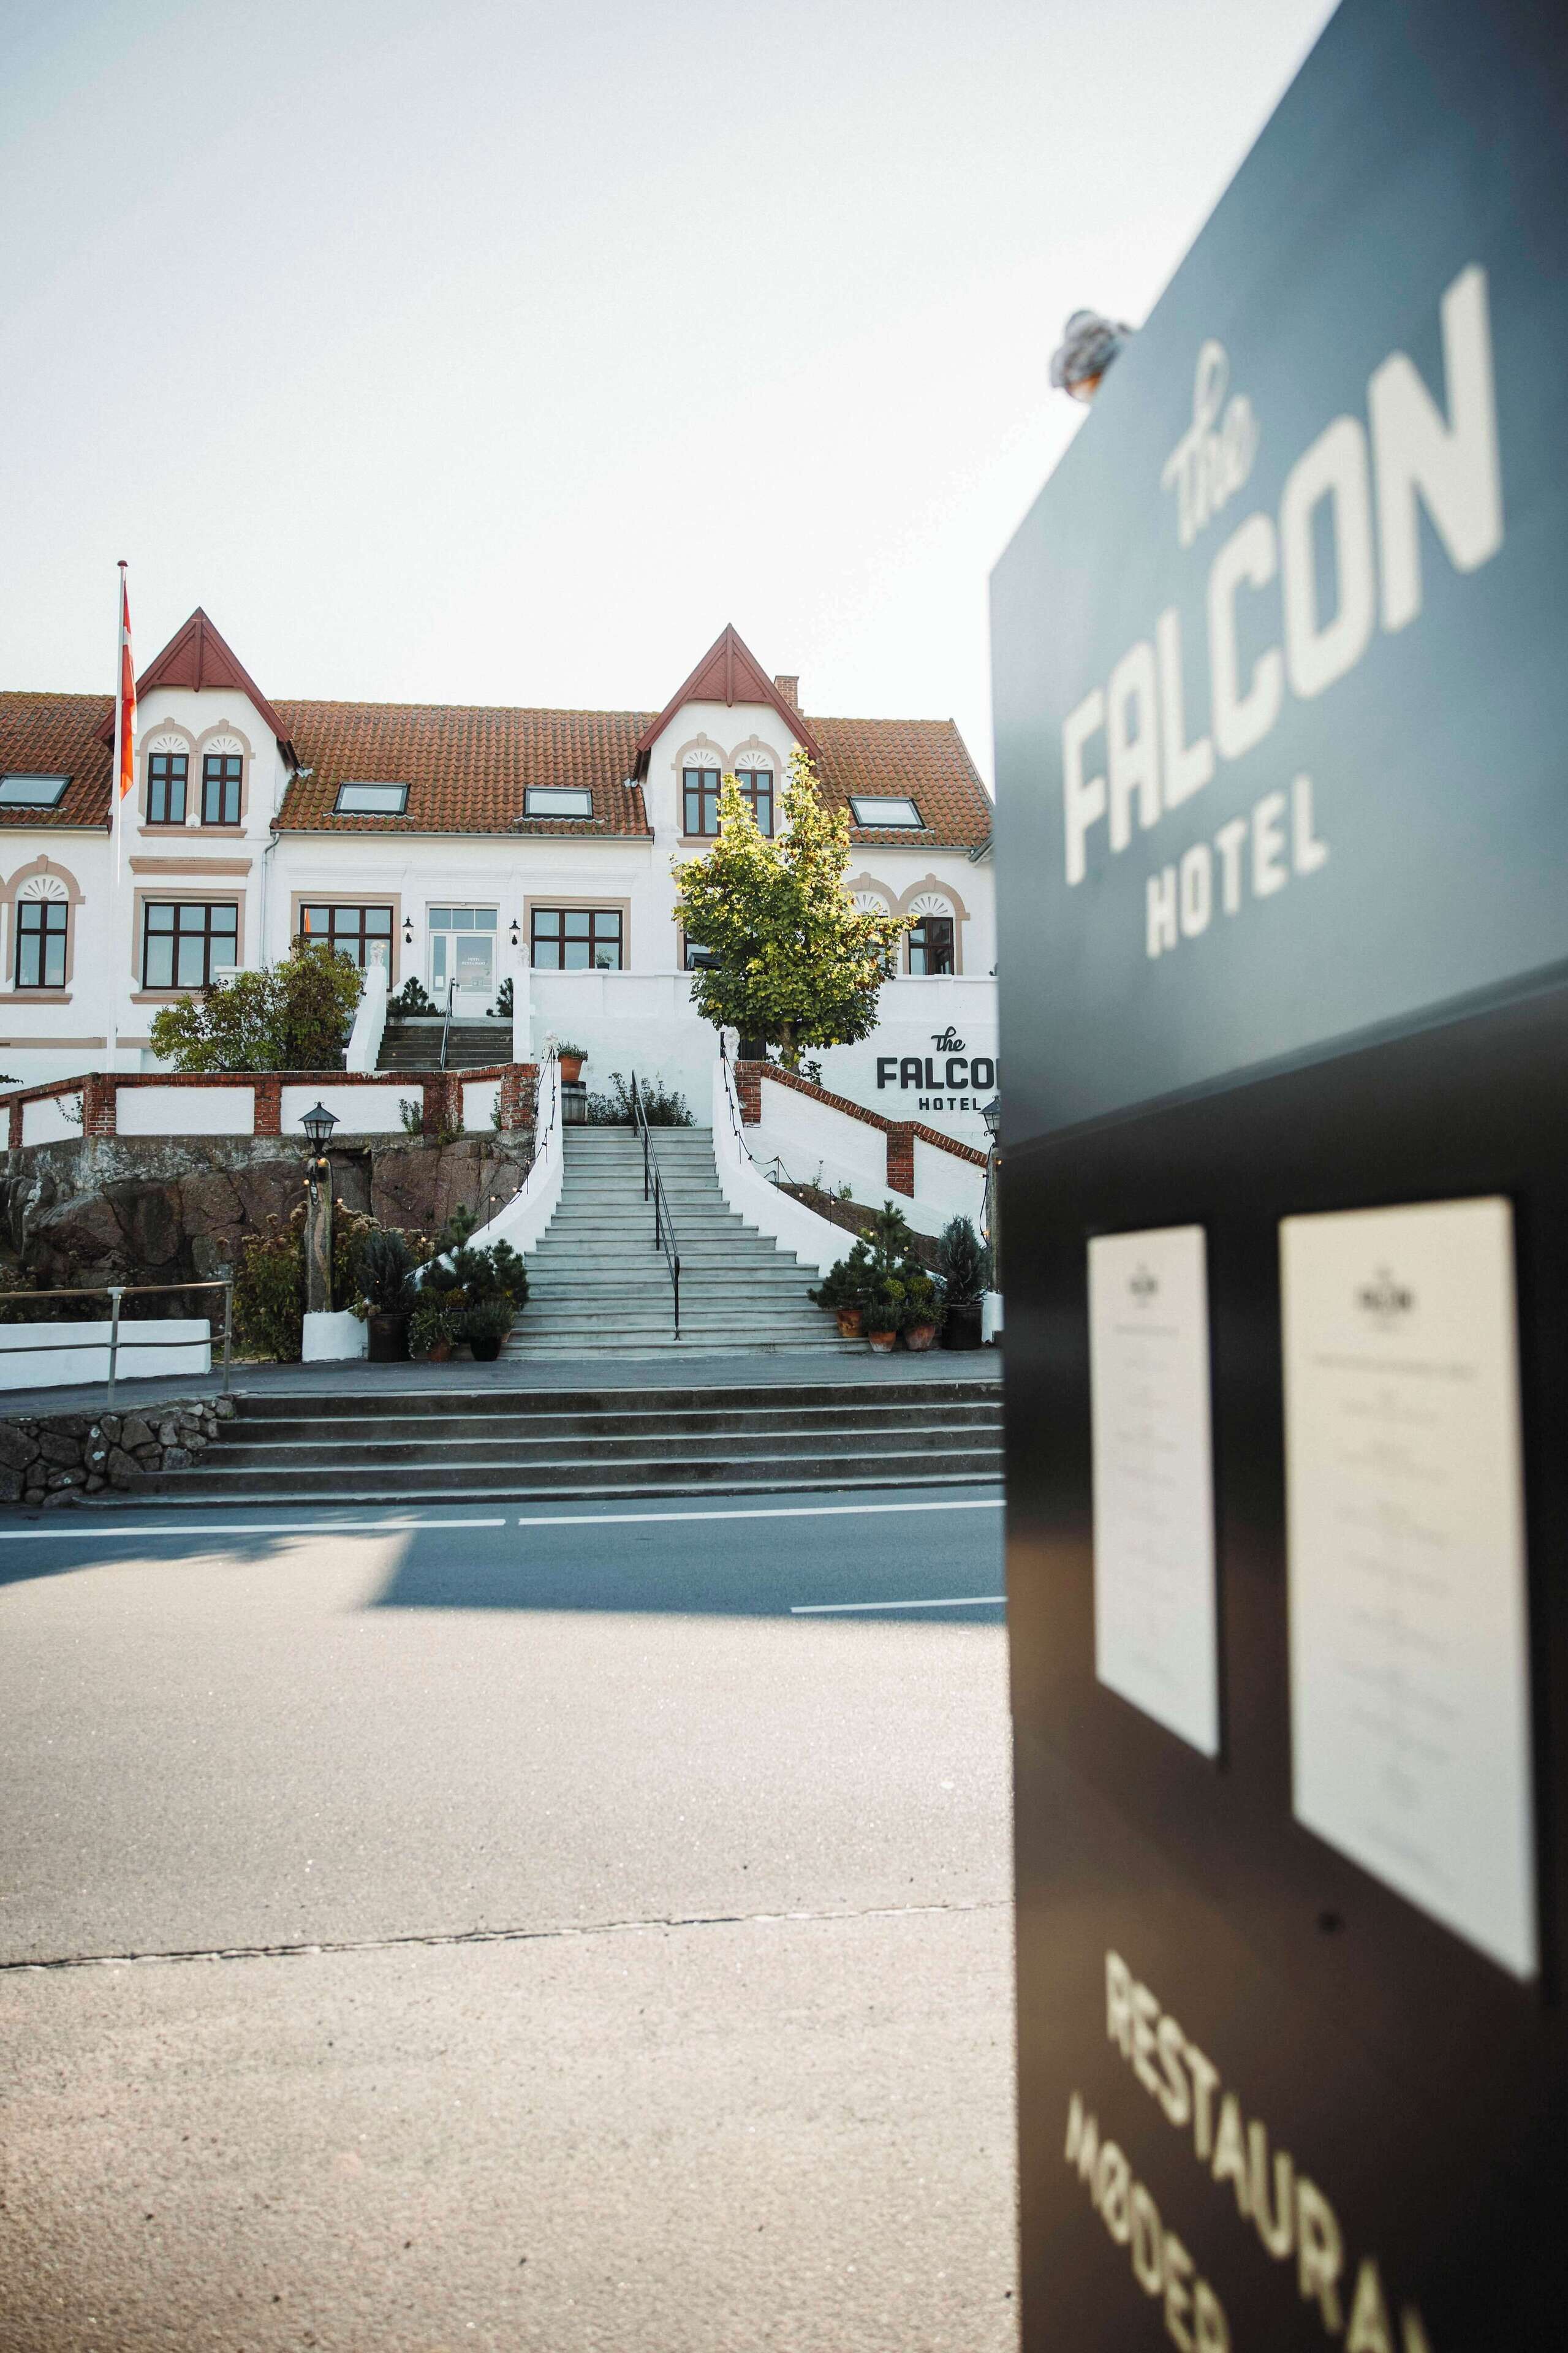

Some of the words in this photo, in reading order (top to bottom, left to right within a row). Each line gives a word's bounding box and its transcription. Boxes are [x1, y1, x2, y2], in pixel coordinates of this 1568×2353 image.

[1063, 263, 1503, 887] FALCON
[1145, 774, 1330, 958] HOTEL
[877, 1057, 1000, 1089] FALCO
[918, 1097, 982, 1111] HOTEL
[1105, 1947, 1433, 2353] RESTAURA
